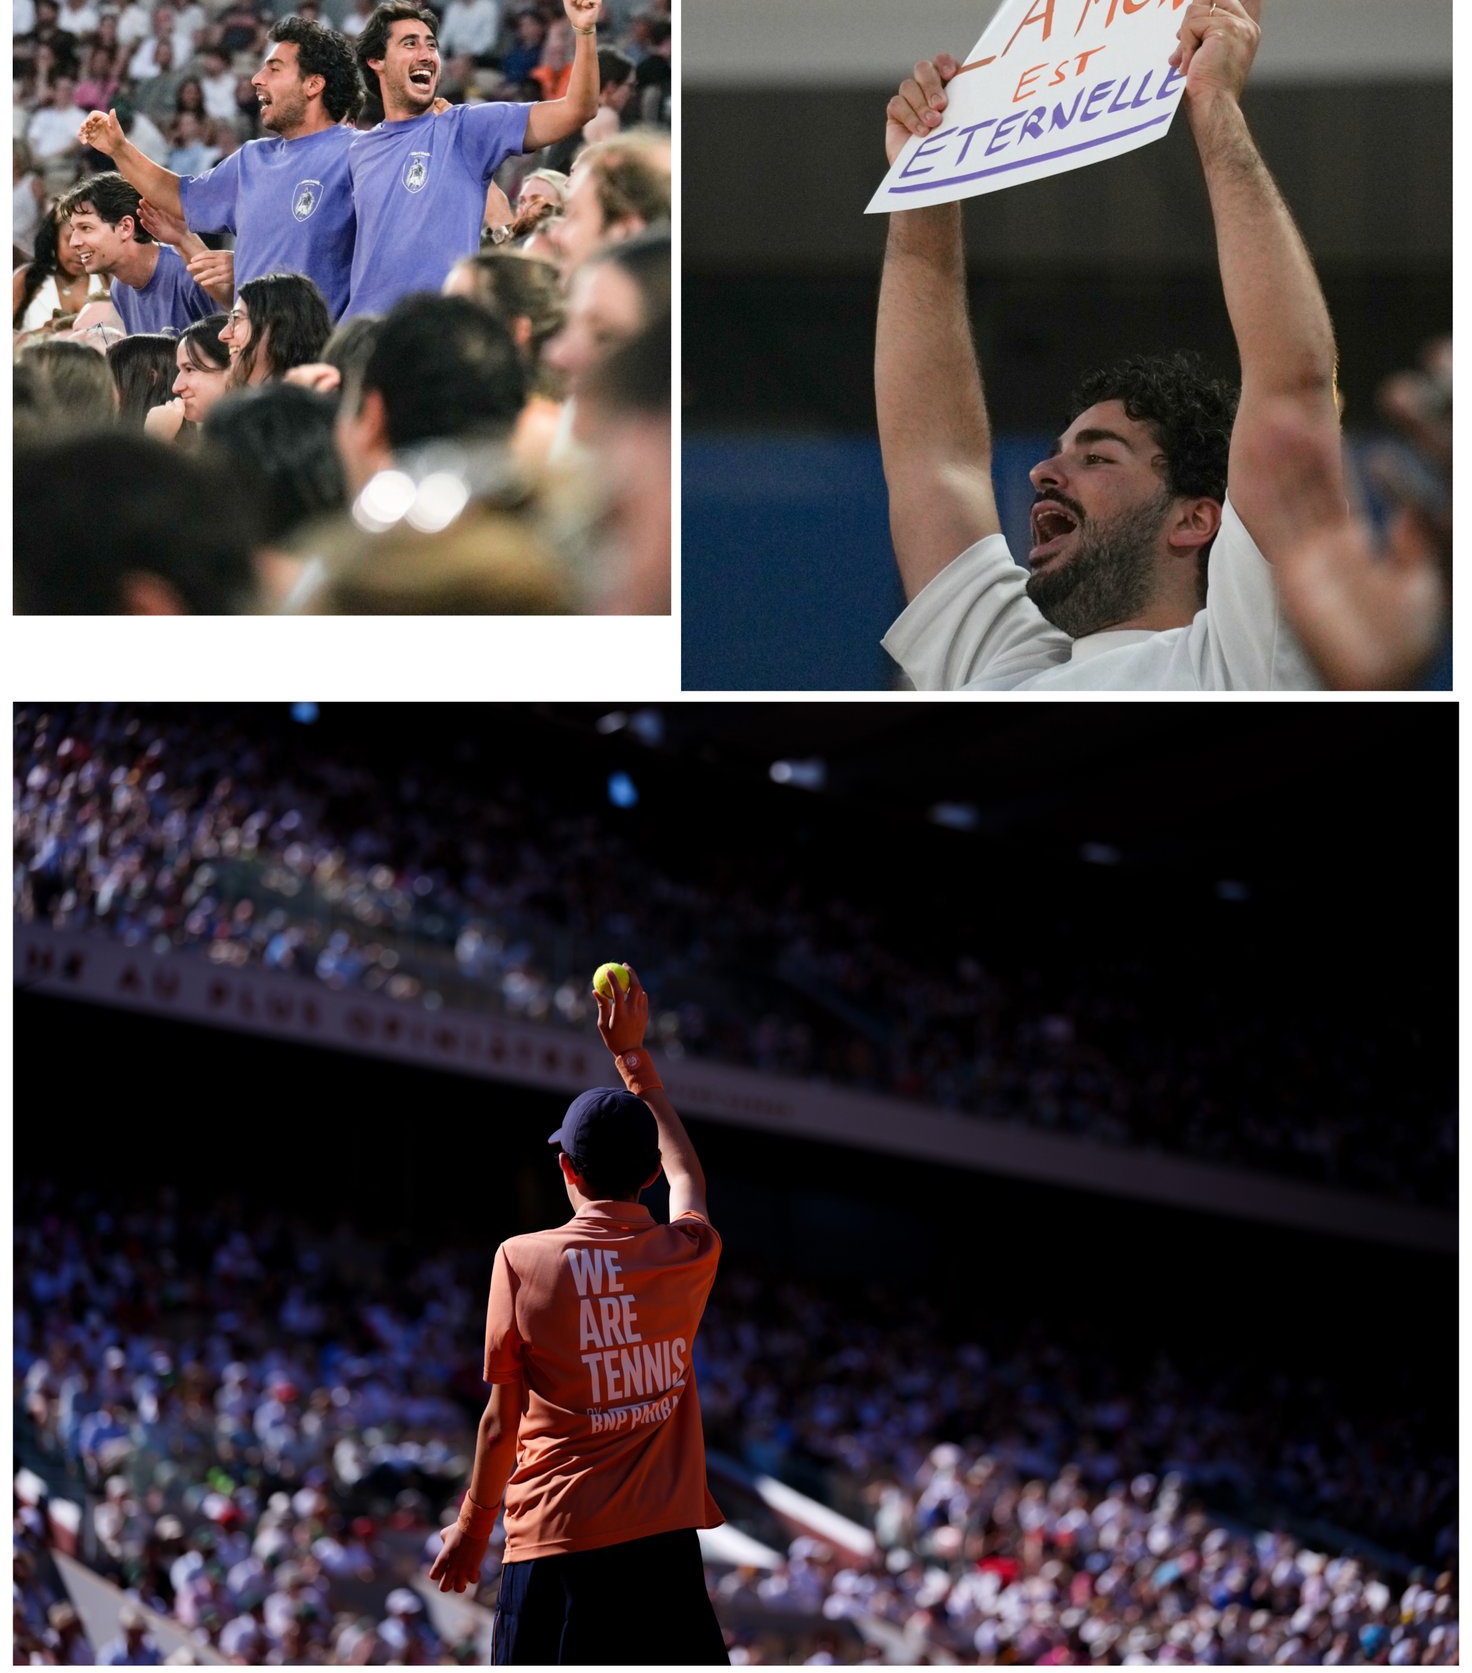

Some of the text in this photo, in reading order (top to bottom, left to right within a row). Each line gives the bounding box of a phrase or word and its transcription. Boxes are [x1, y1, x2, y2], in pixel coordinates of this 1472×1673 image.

[1011, 45, 1107, 103] EST
[898, 66, 1187, 179] ETERNELLE
[566, 1248, 625, 1296] WE
[579, 1294, 642, 1351] ARE
[581, 1337, 687, 1404] TENNIS
[591, 1410, 628, 1434] BNP
